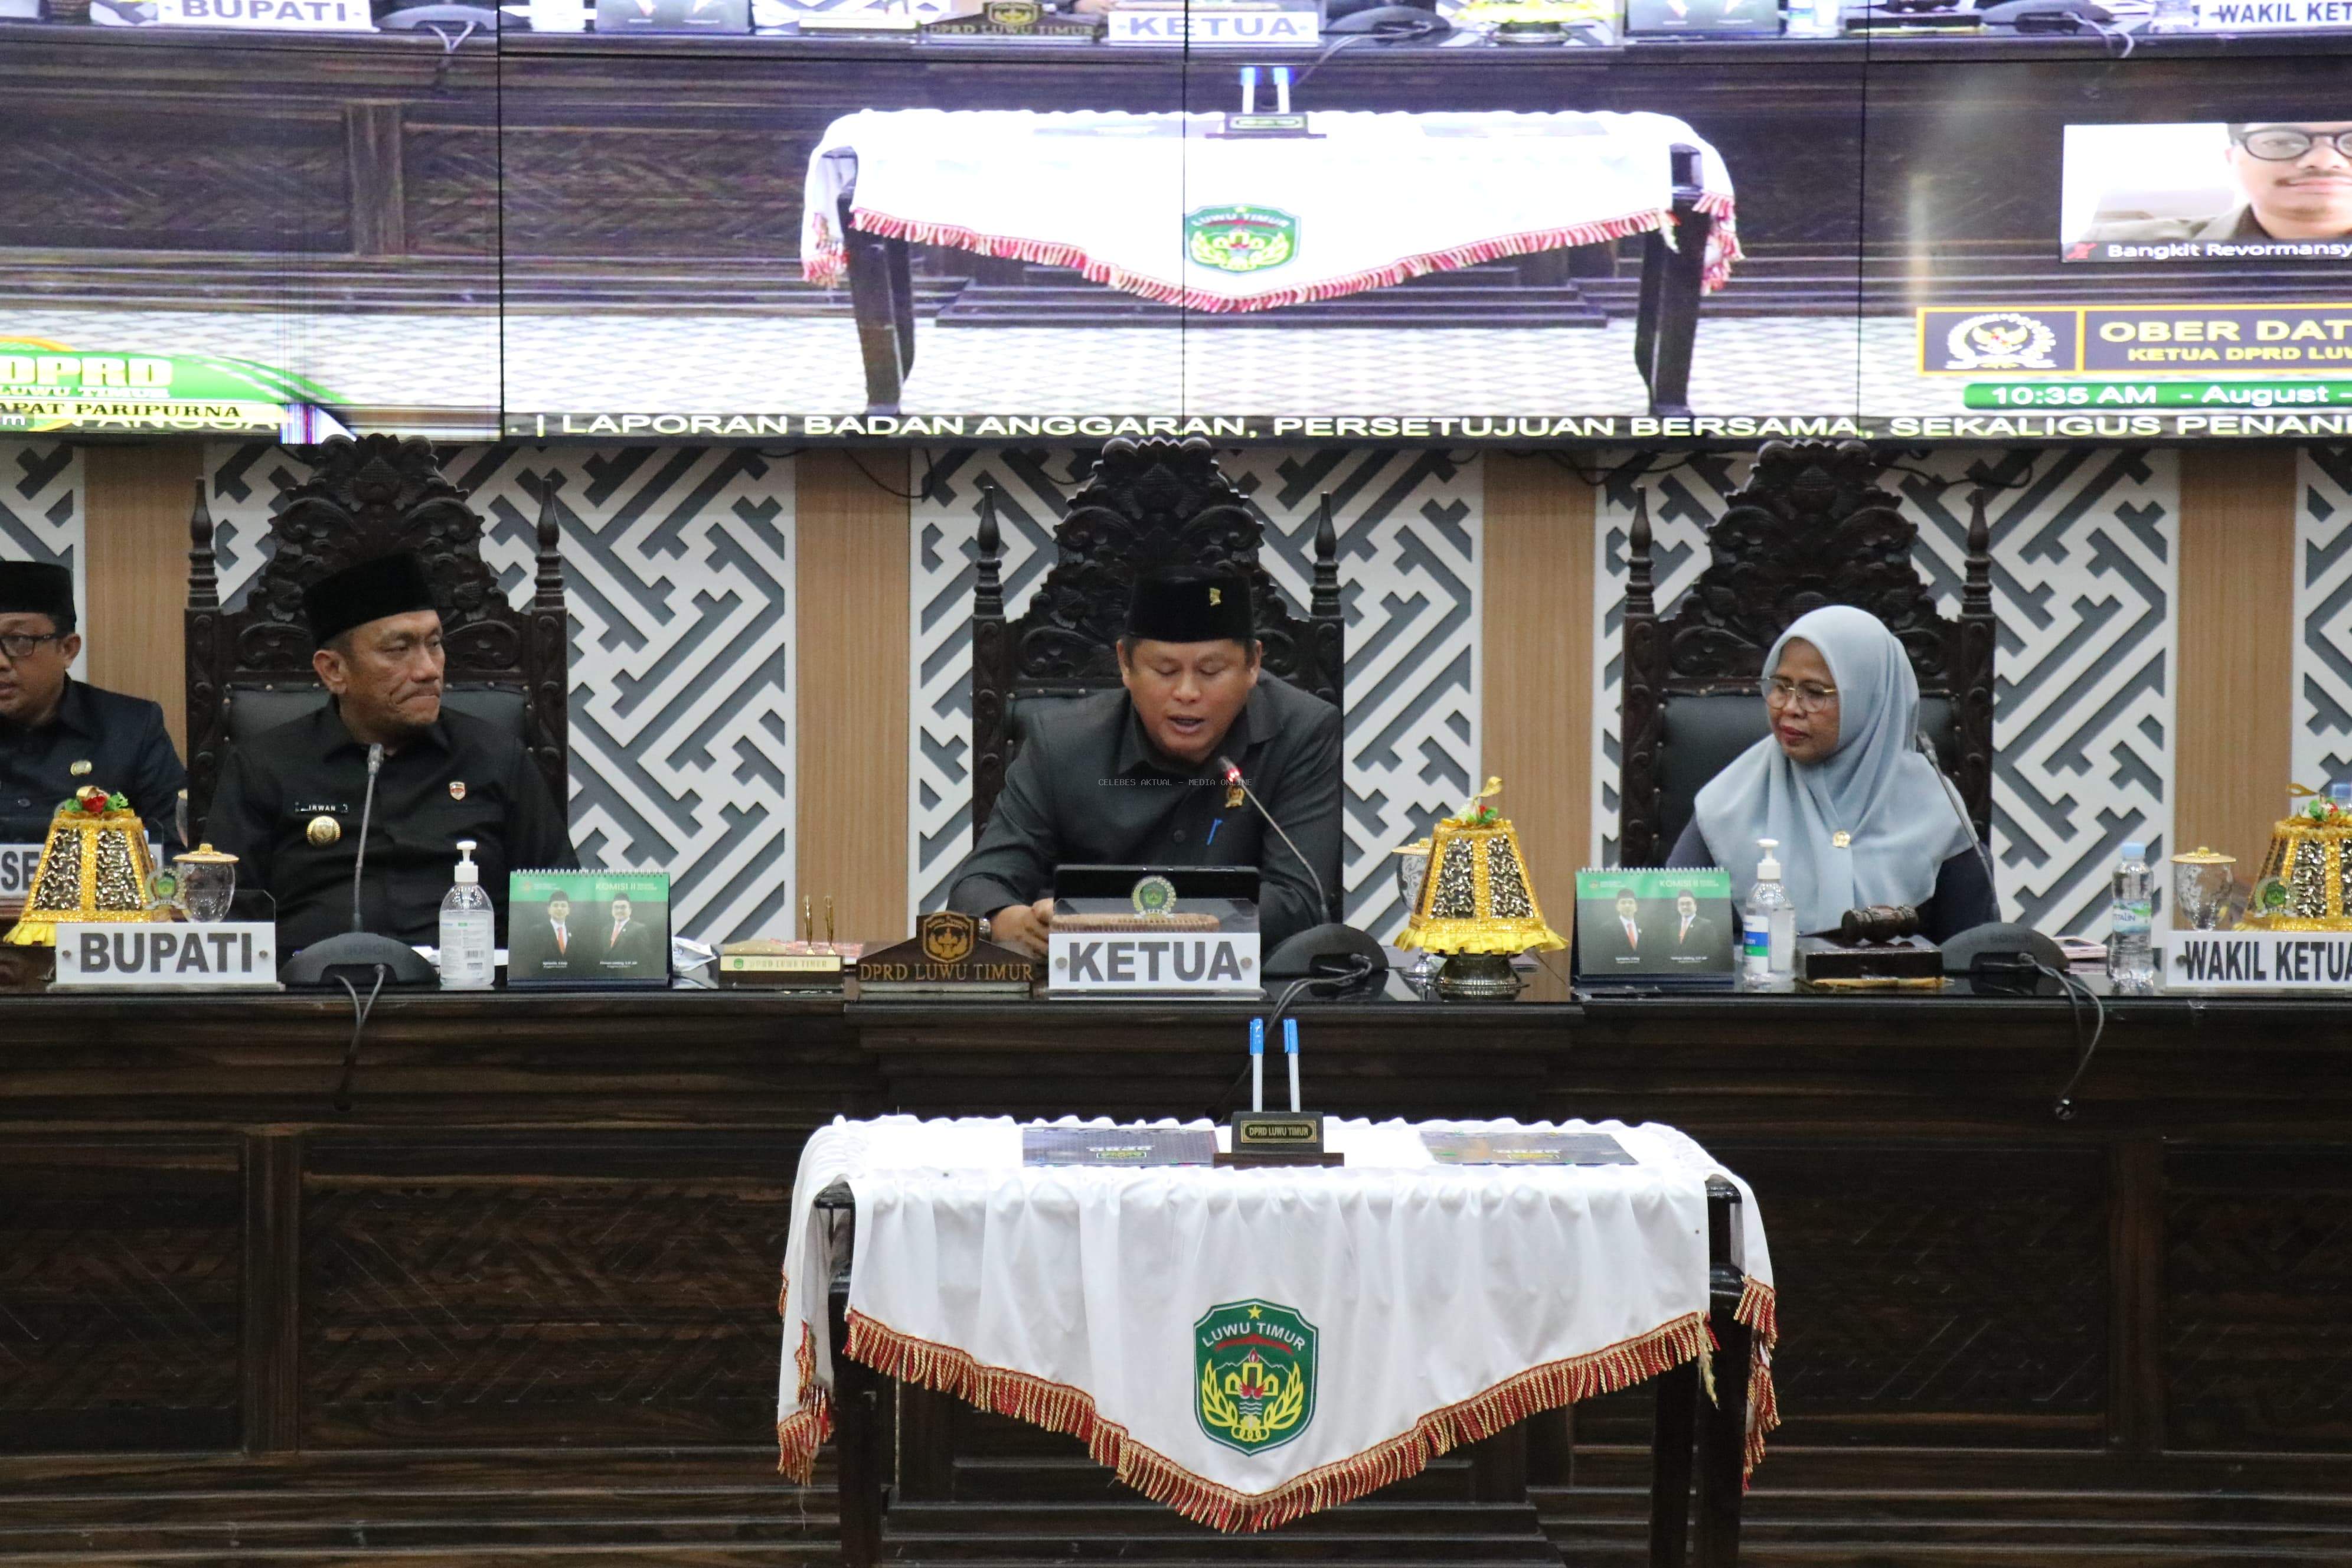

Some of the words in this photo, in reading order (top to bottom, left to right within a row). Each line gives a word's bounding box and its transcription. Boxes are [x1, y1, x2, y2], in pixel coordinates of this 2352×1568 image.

[182, 0, 346, 21] BUPATI
[2218, 3, 2297, 23] WAKIL
[982, 25, 1033, 35] LUWU
[1040, 25, 1094, 36] TIMUR
[1129, 17, 1298, 37] KETUA
[2108, 243, 2200, 260] Bangkit
[2099, 321, 2241, 342] OBER
[2128, 347, 2220, 361] KETUA
[2226, 347, 2301, 361] DPRD
[0, 355, 173, 387] DPRD
[1992, 387, 2090, 405] 10:35
[2096, 386, 2157, 404] AM
[2201, 385, 2329, 407] August
[76, 403, 241, 418] PARIPURNA
[561, 415, 788, 435] LAPORAN
[804, 416, 963, 435] BADAN
[976, 416, 1257, 438] ANGGARAN,
[1274, 416, 1614, 436] PERSETUJUAN
[1630, 417, 1875, 439] BERSAMA,
[1889, 416, 2161, 437] SEKALIGUS
[595, 883, 628, 891] KOMISI
[80, 932, 252, 973] BUPATI
[1069, 941, 1243, 982] KETUA
[2184, 940, 2267, 981] WAKIL
[860, 963, 908, 981] DPRD
[915, 963, 967, 981] LUWU
[974, 963, 1033, 981] TIMUR
[1249, 1126, 1268, 1136] DPRD
[1269, 1126, 1287, 1136] LUWU
[1288, 1126, 1309, 1136] TIMUR
[1201, 1322, 1250, 1347] LUWU
[1256, 1322, 1306, 1351] TIMUR
